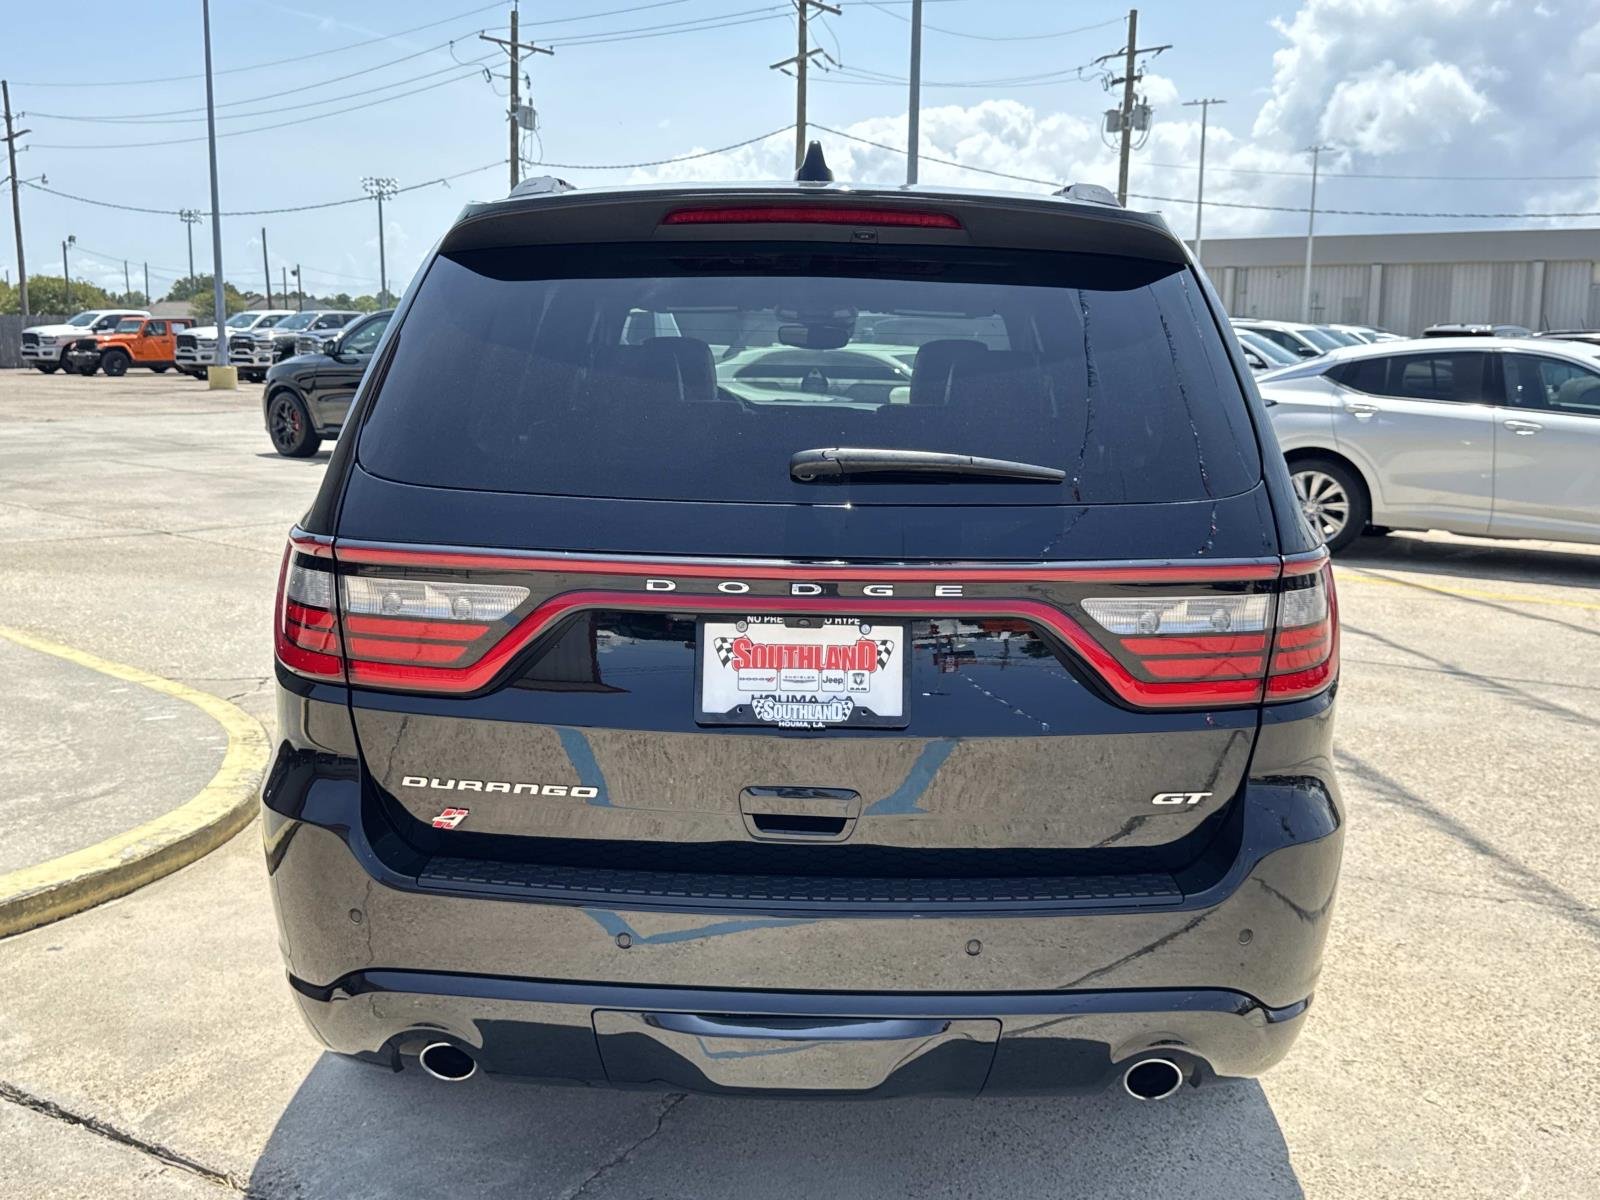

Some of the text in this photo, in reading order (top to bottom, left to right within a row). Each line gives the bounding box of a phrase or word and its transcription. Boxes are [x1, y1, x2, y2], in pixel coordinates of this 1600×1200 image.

[646, 579, 963, 597] DODGE
[835, 617, 861, 626] HYPE
[732, 637, 877, 673] SOUTHLAND
[822, 675, 844, 686] Jeep
[763, 700, 844, 721] SOUTHLAND
[402, 775, 599, 799] DURANGO
[1152, 792, 1213, 805] GT
